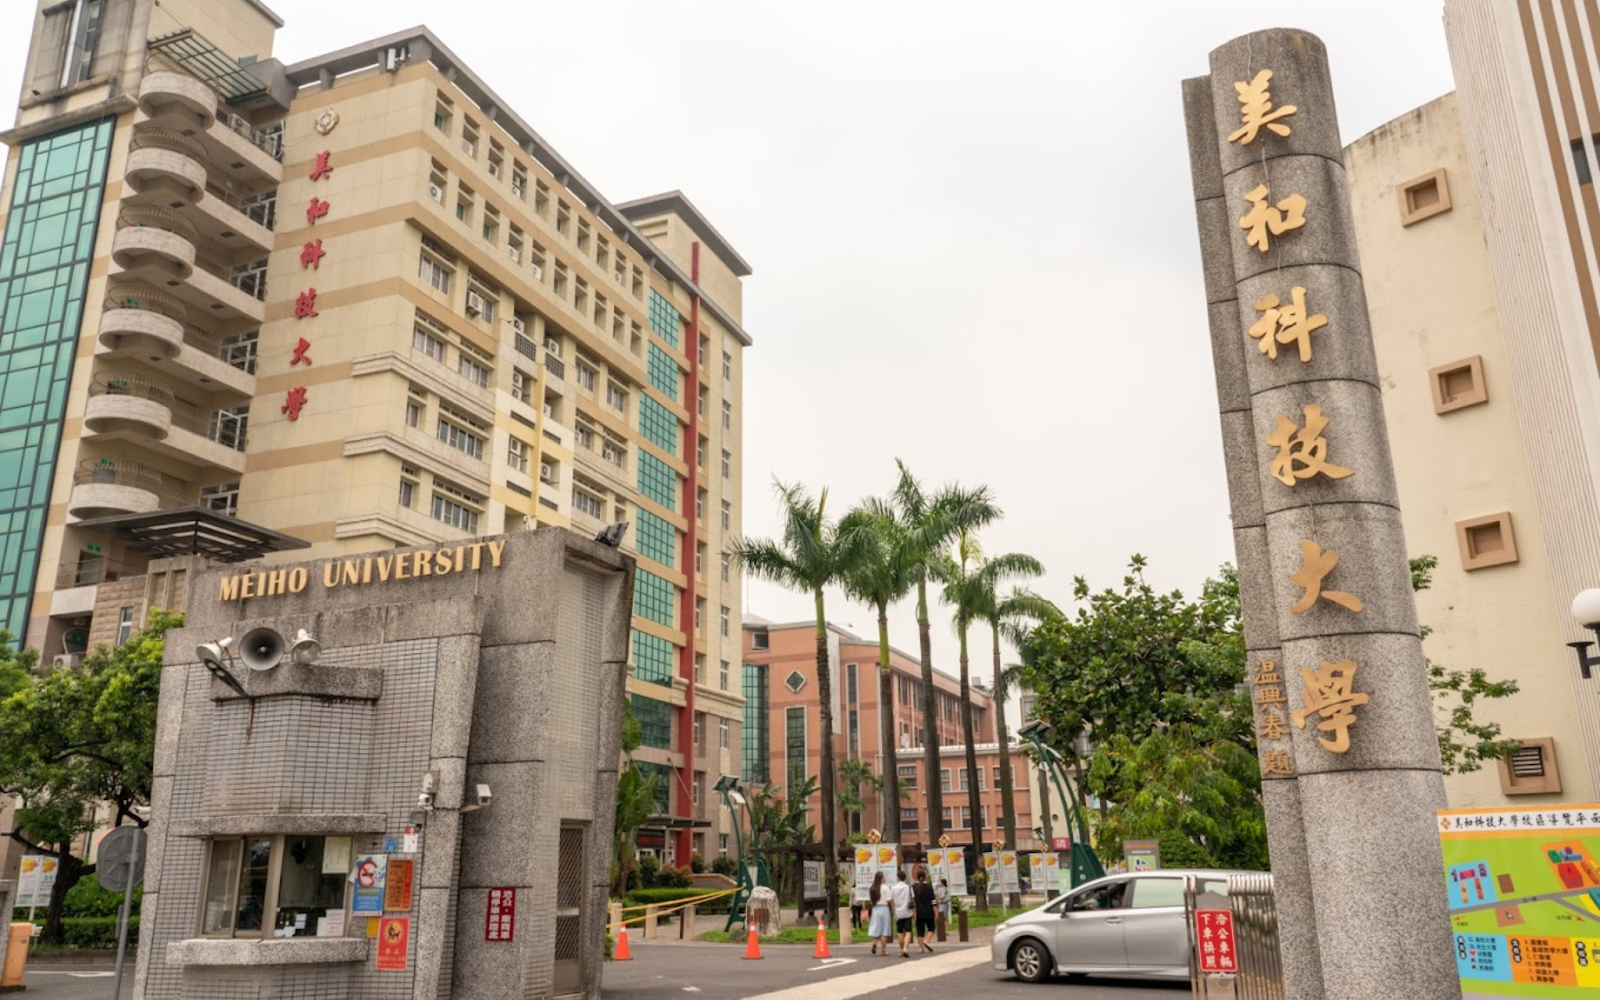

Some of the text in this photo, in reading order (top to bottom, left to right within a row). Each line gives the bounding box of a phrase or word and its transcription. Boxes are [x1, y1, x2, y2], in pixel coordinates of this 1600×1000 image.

[281, 149, 334, 421] 美和科技大學
[1228, 68, 1370, 754] 美和科技大學
[218, 540, 507, 601] MEIHO UNIVERSITY
[1215, 912, 1233, 968] 洽公車輛
